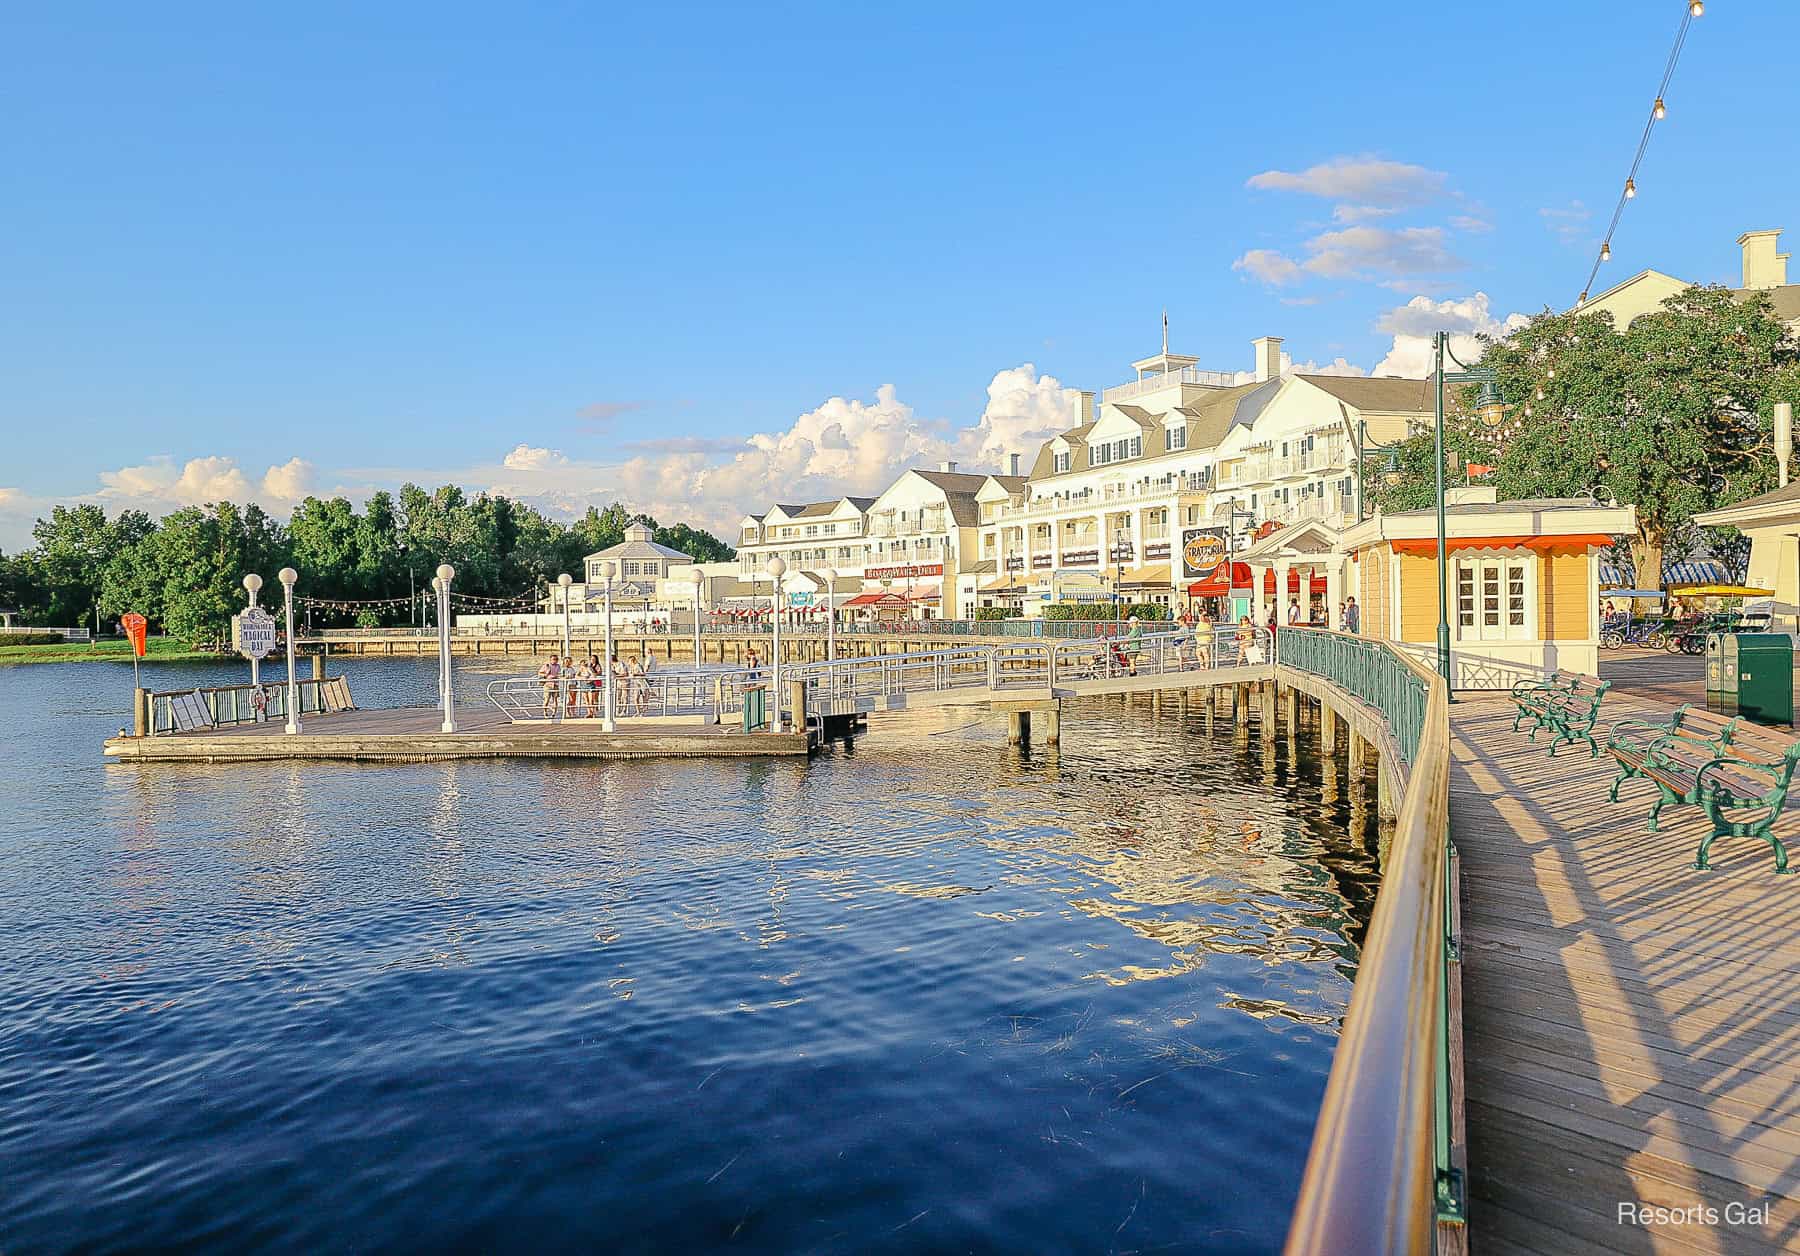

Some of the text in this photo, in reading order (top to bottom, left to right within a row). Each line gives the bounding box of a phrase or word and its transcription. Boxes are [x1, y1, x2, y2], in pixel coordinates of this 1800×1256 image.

[1188, 544, 1223, 557] TRATTORIA
[918, 565, 937, 576] DELI
[243, 630, 271, 641] MAGICAL
